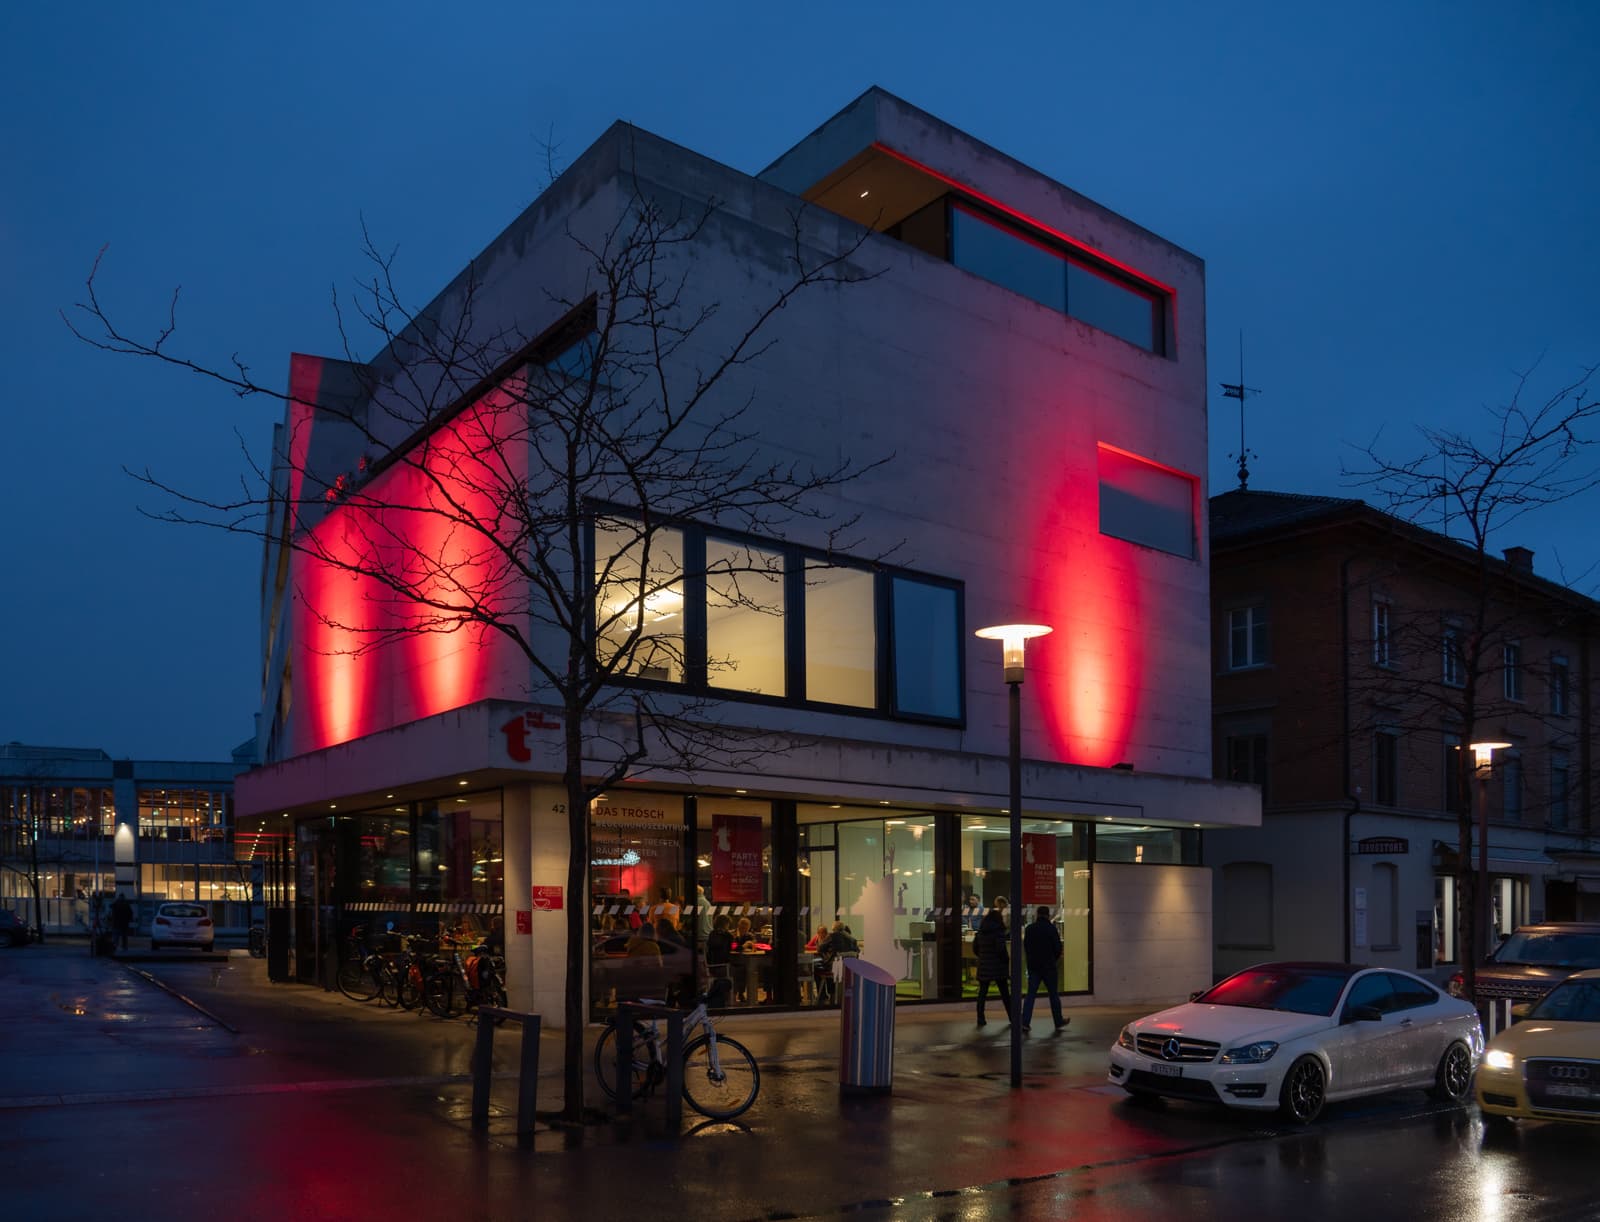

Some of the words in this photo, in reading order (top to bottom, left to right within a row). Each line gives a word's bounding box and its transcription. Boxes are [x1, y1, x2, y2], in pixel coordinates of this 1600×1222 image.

[552, 804, 565, 814] 42
[595, 807, 618, 817] DAS
[731, 853, 758, 861] PARTY
